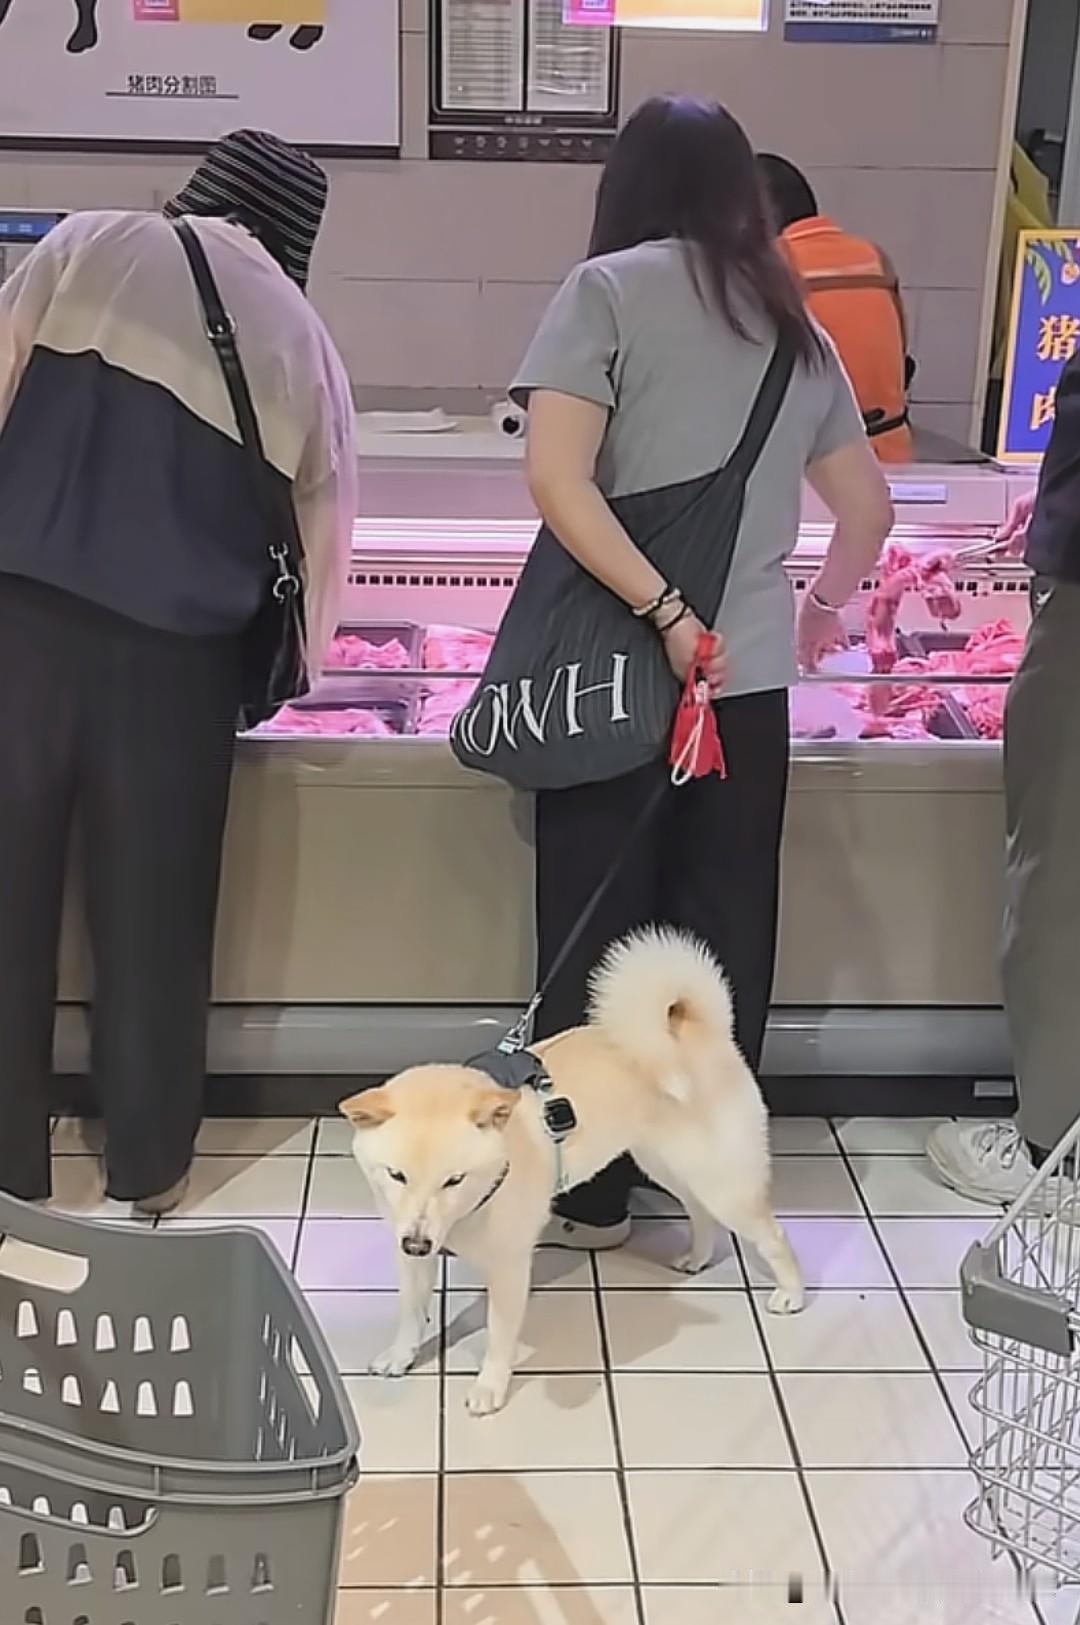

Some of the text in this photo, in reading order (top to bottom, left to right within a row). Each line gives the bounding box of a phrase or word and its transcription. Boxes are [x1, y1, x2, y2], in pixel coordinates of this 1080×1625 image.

[127, 75, 217, 95] 猪肉分割图
